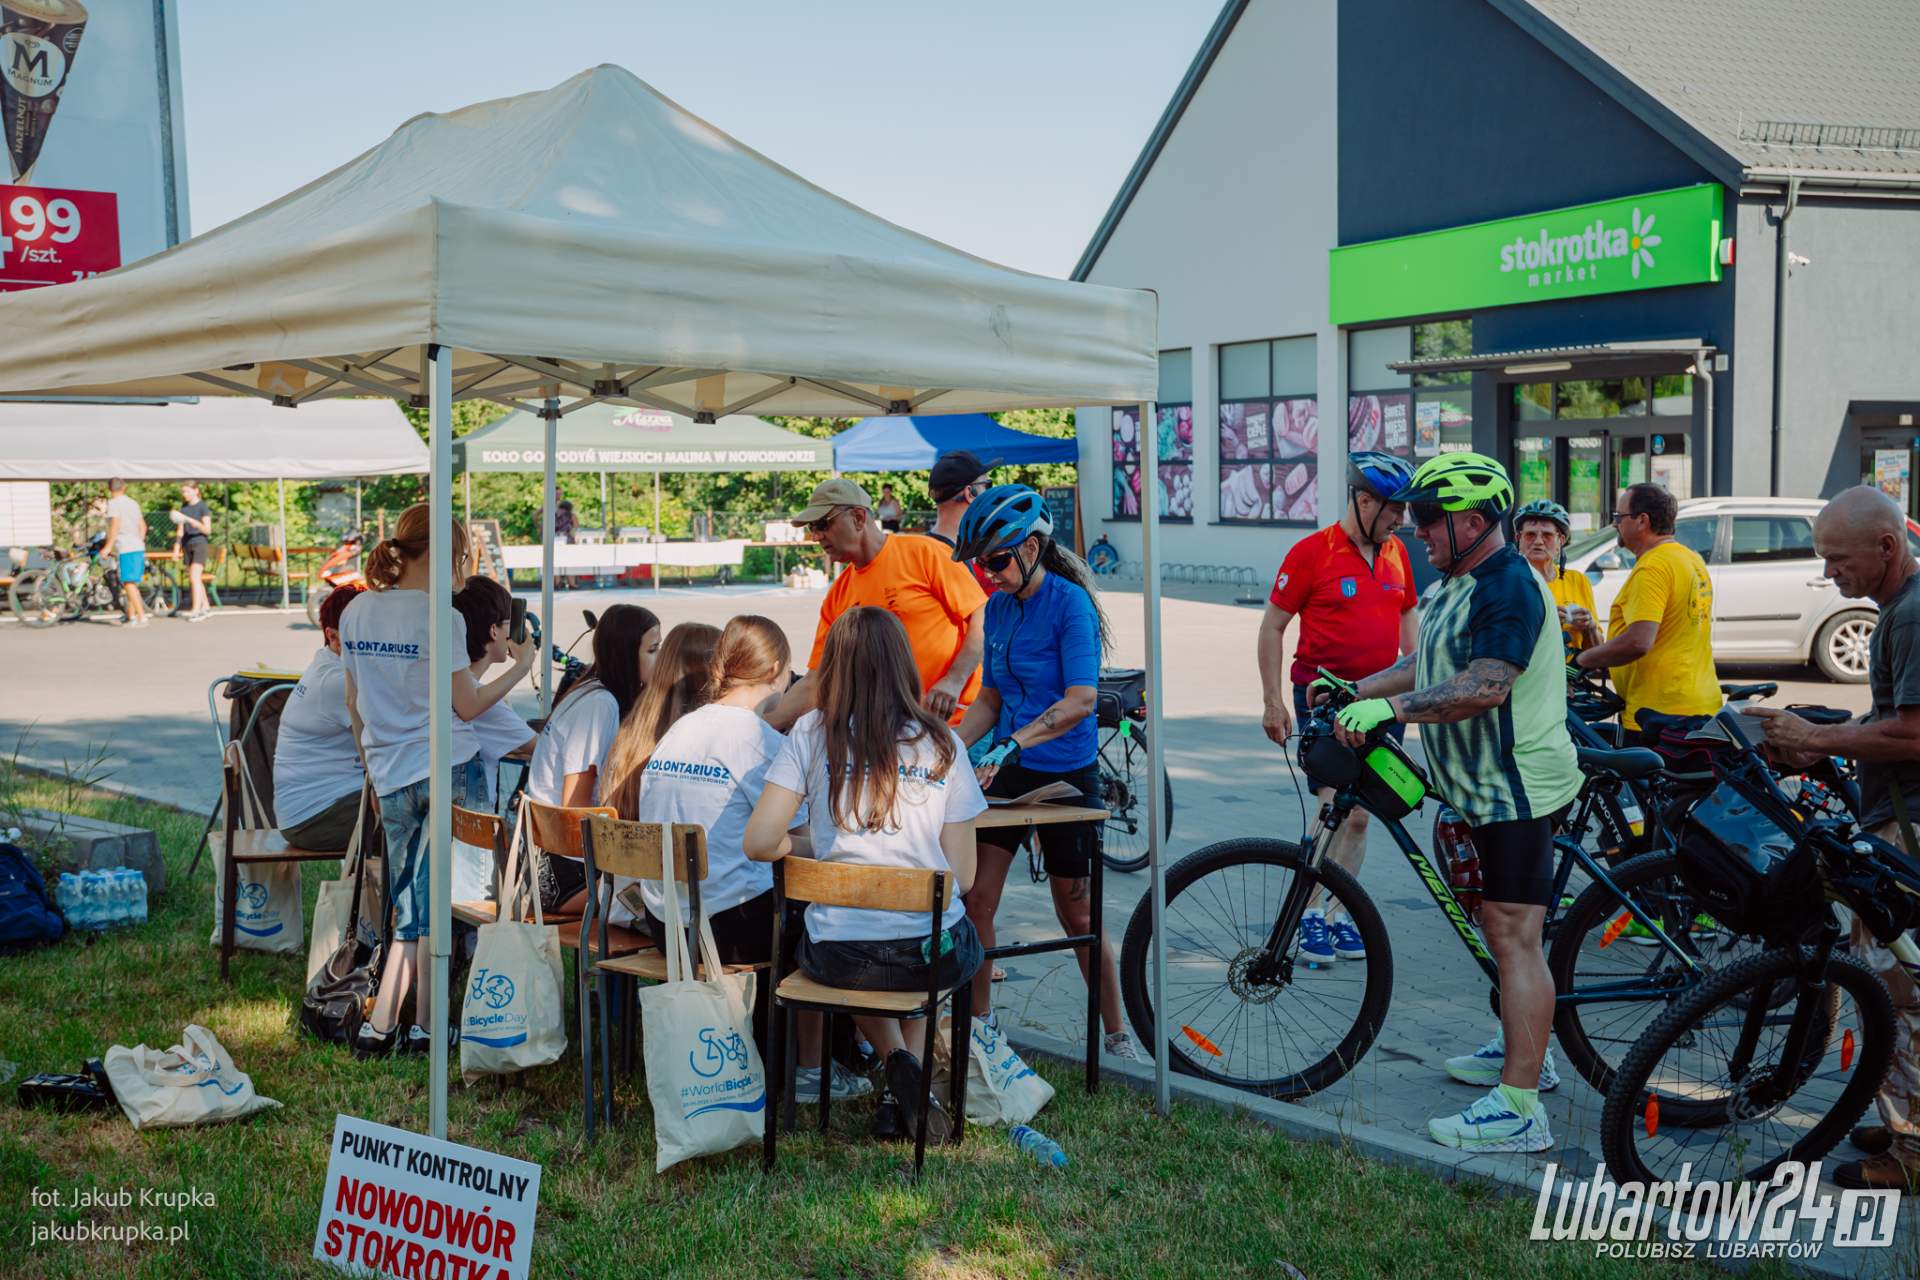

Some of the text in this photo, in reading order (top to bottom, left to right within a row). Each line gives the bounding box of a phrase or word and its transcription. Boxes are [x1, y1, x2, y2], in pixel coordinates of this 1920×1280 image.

[12, 39, 49, 78] M
[8, 67, 53, 87] MAGNUM
[1500, 219, 1630, 273] stokrotka
[1528, 263, 1597, 287] market
[482, 448, 816, 463] KOŁO GOODYŃ WIEJSKICH MALINA W NOWODWORZE
[646, 760, 730, 779] VOLONTARIUSZ
[340, 1131, 529, 1201] PUNKT KONTROLNY
[335, 1175, 516, 1262] NOWODWÓR
